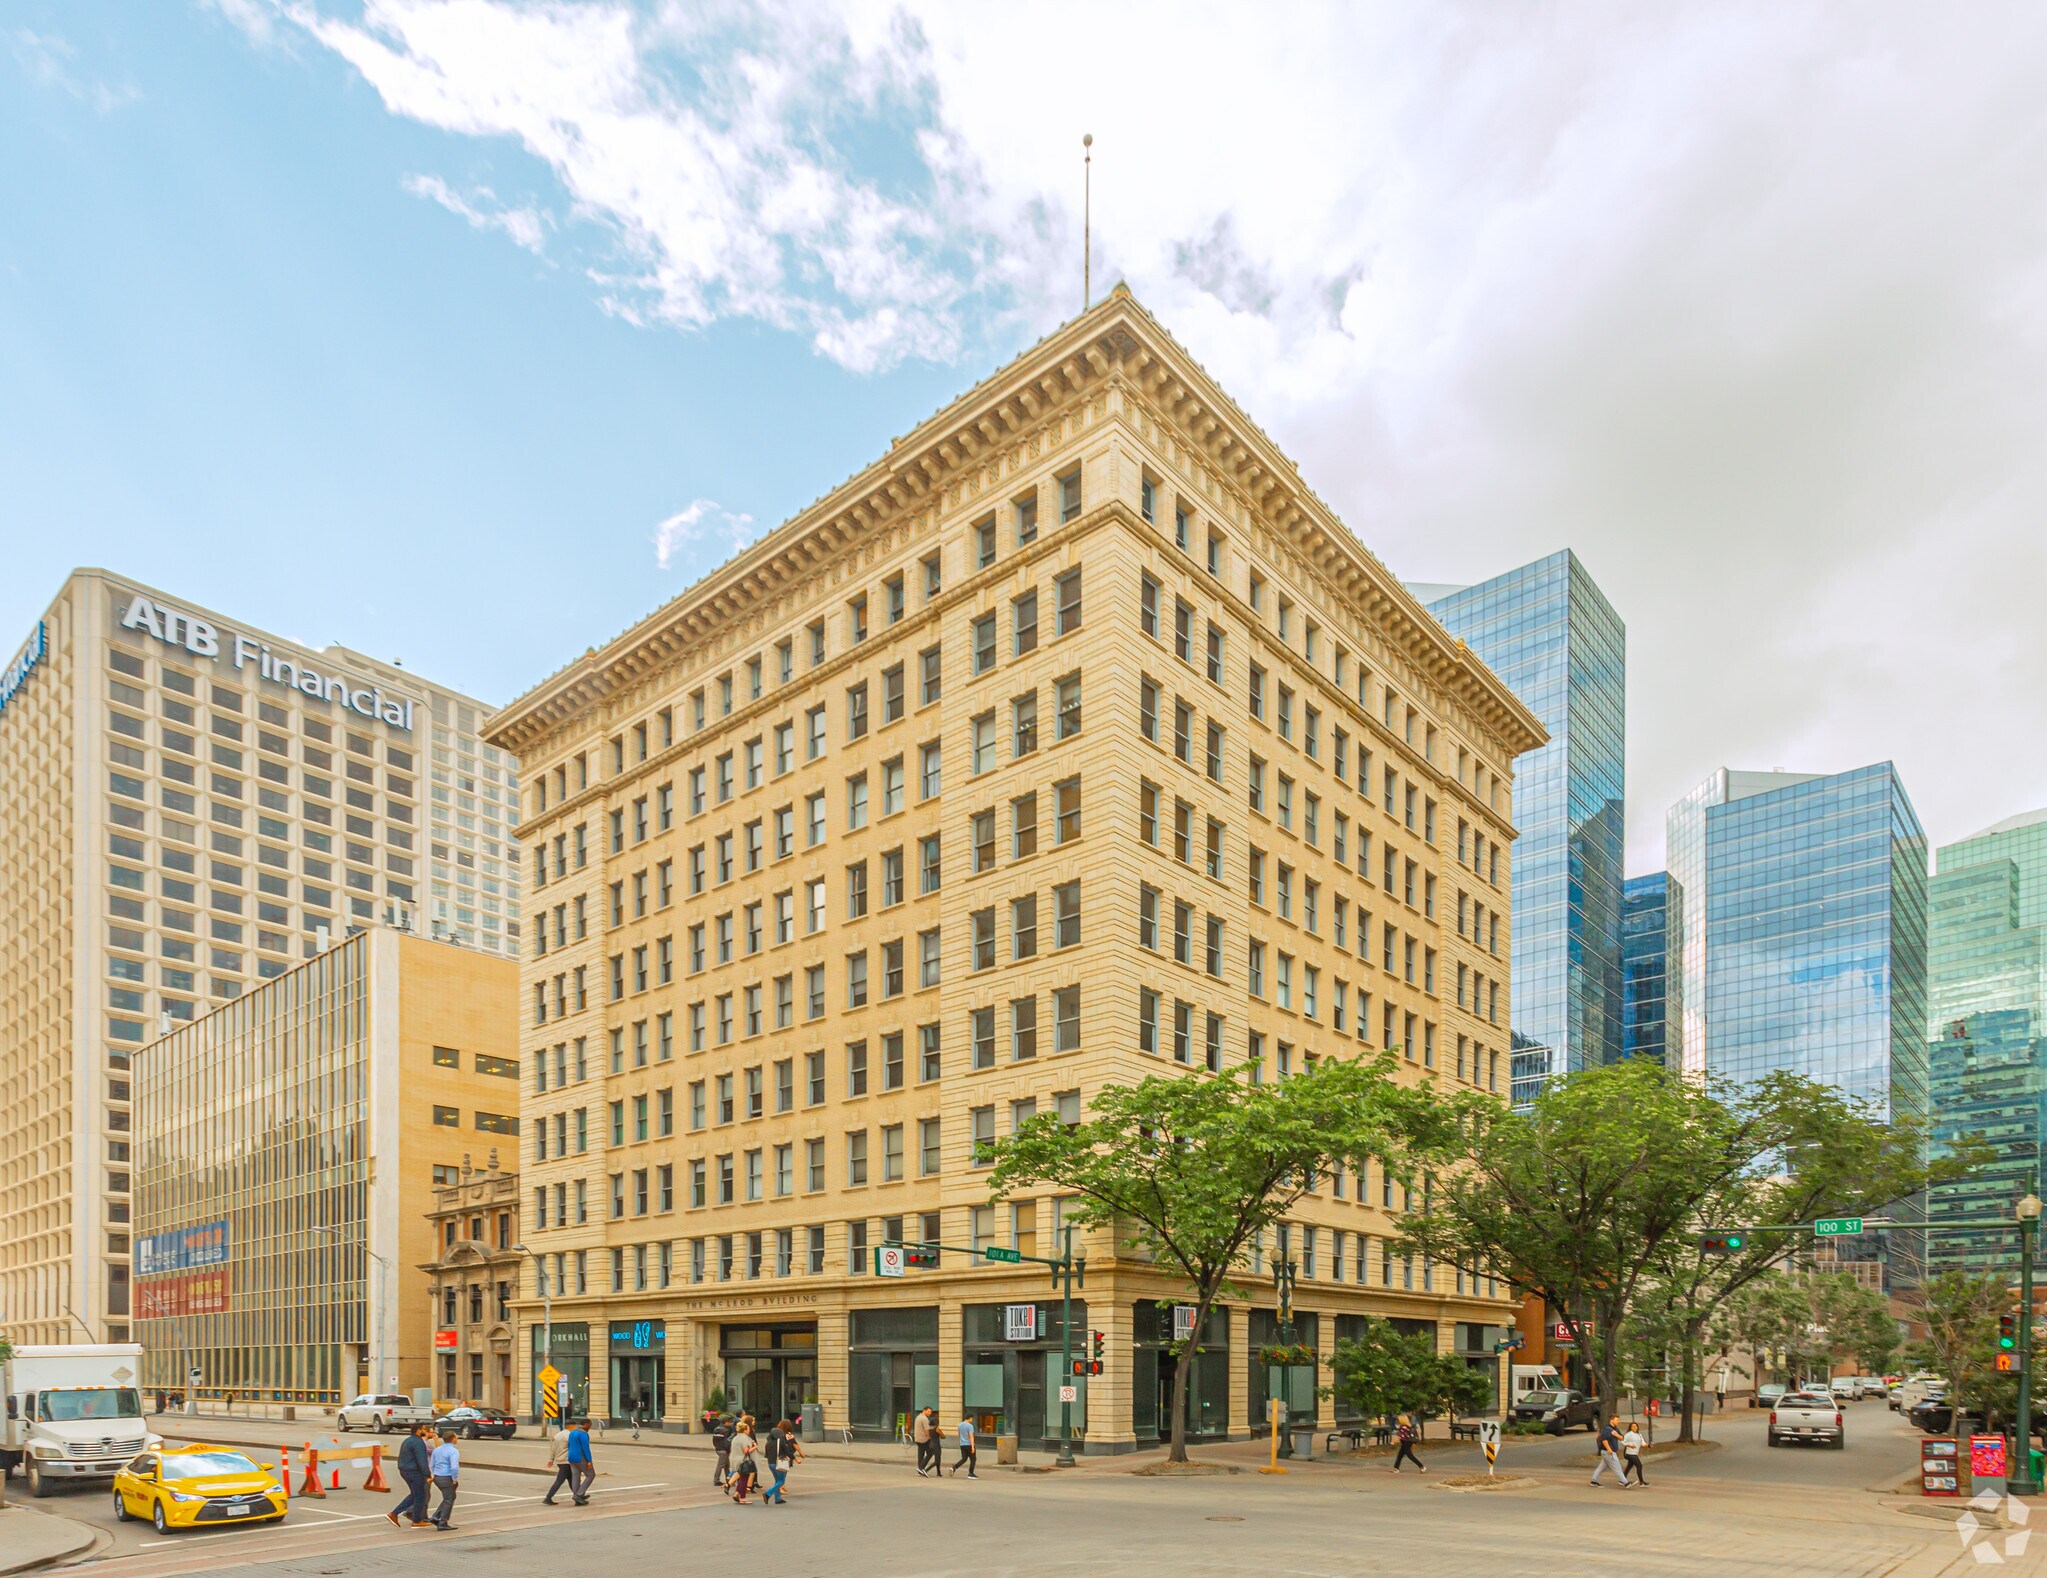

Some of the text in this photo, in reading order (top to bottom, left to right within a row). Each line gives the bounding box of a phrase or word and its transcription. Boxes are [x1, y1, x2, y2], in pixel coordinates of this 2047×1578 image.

[120, 595, 413, 732] ATB Financial
[1819, 1221, 1858, 1233] 100 ST
[686, 1301, 703, 1309] THE
[551, 1333, 588, 1342] ORKHALL
[612, 1332, 631, 1340] WOOD
